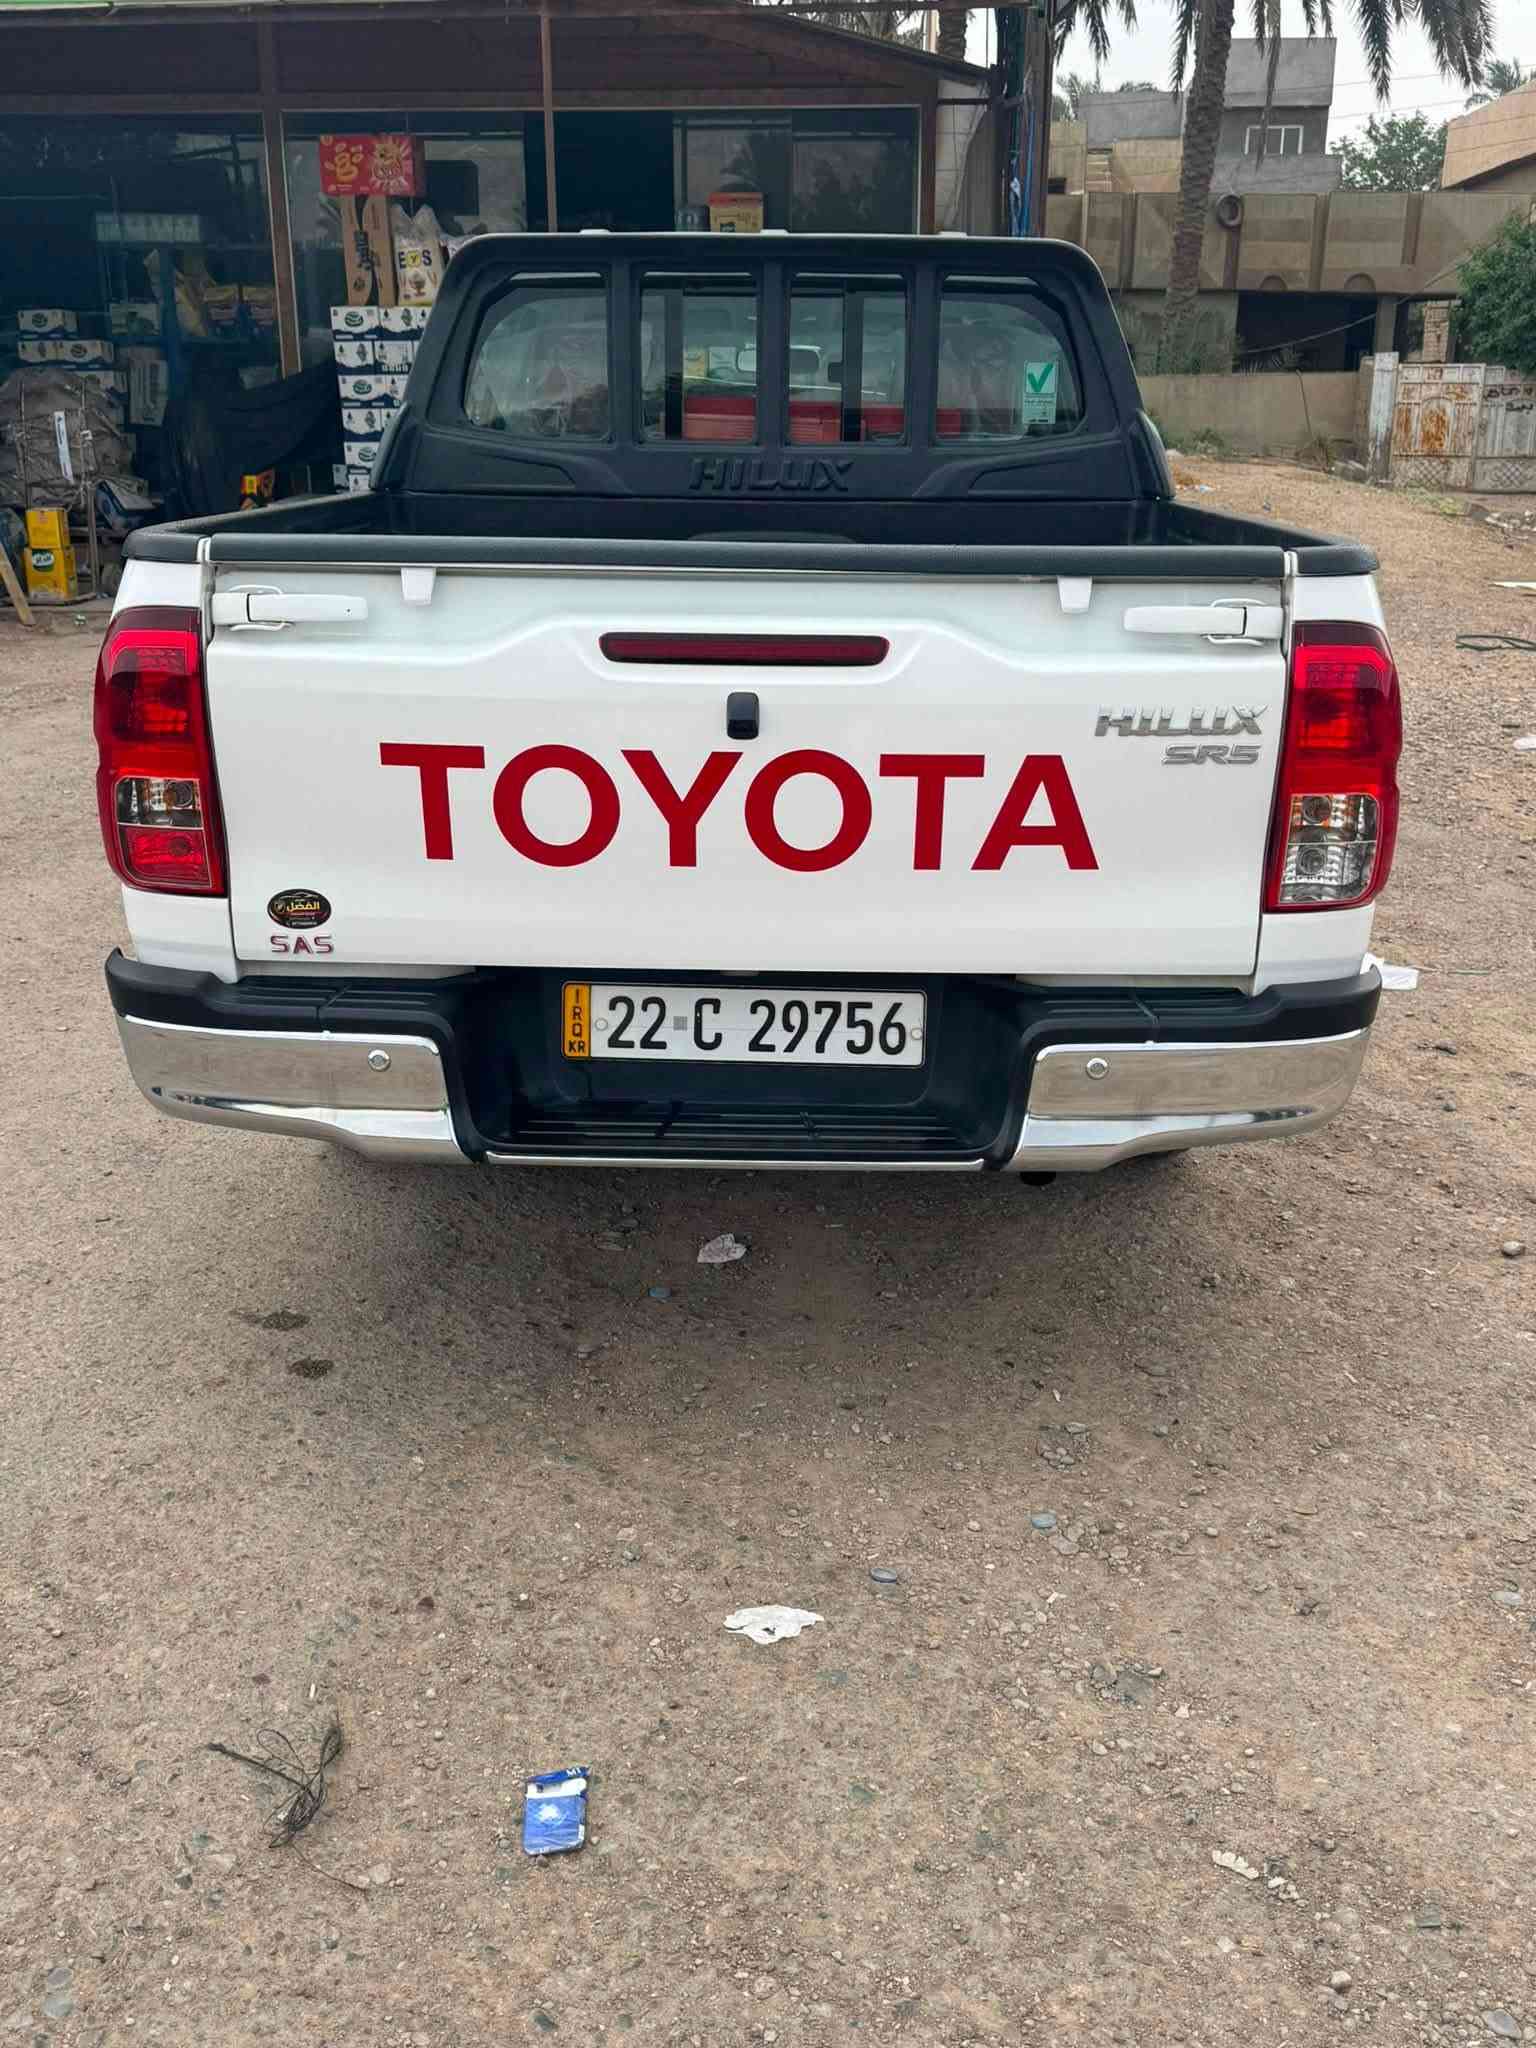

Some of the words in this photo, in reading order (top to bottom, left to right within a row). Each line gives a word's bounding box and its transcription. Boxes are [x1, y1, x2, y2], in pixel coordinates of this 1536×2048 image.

[688, 457, 854, 491] HILUX
[1094, 703, 1268, 737] HILUX
[1162, 744, 1262, 765] SR5
[379, 742, 1100, 873] TOYOTA
[270, 935, 334, 954] SAS
[572, 988, 583, 1038] IRQ
[607, 995, 668, 1050] 22
[693, 997, 723, 1051] C
[748, 999, 906, 1056] 29756
[568, 1040, 586, 1052] KR
